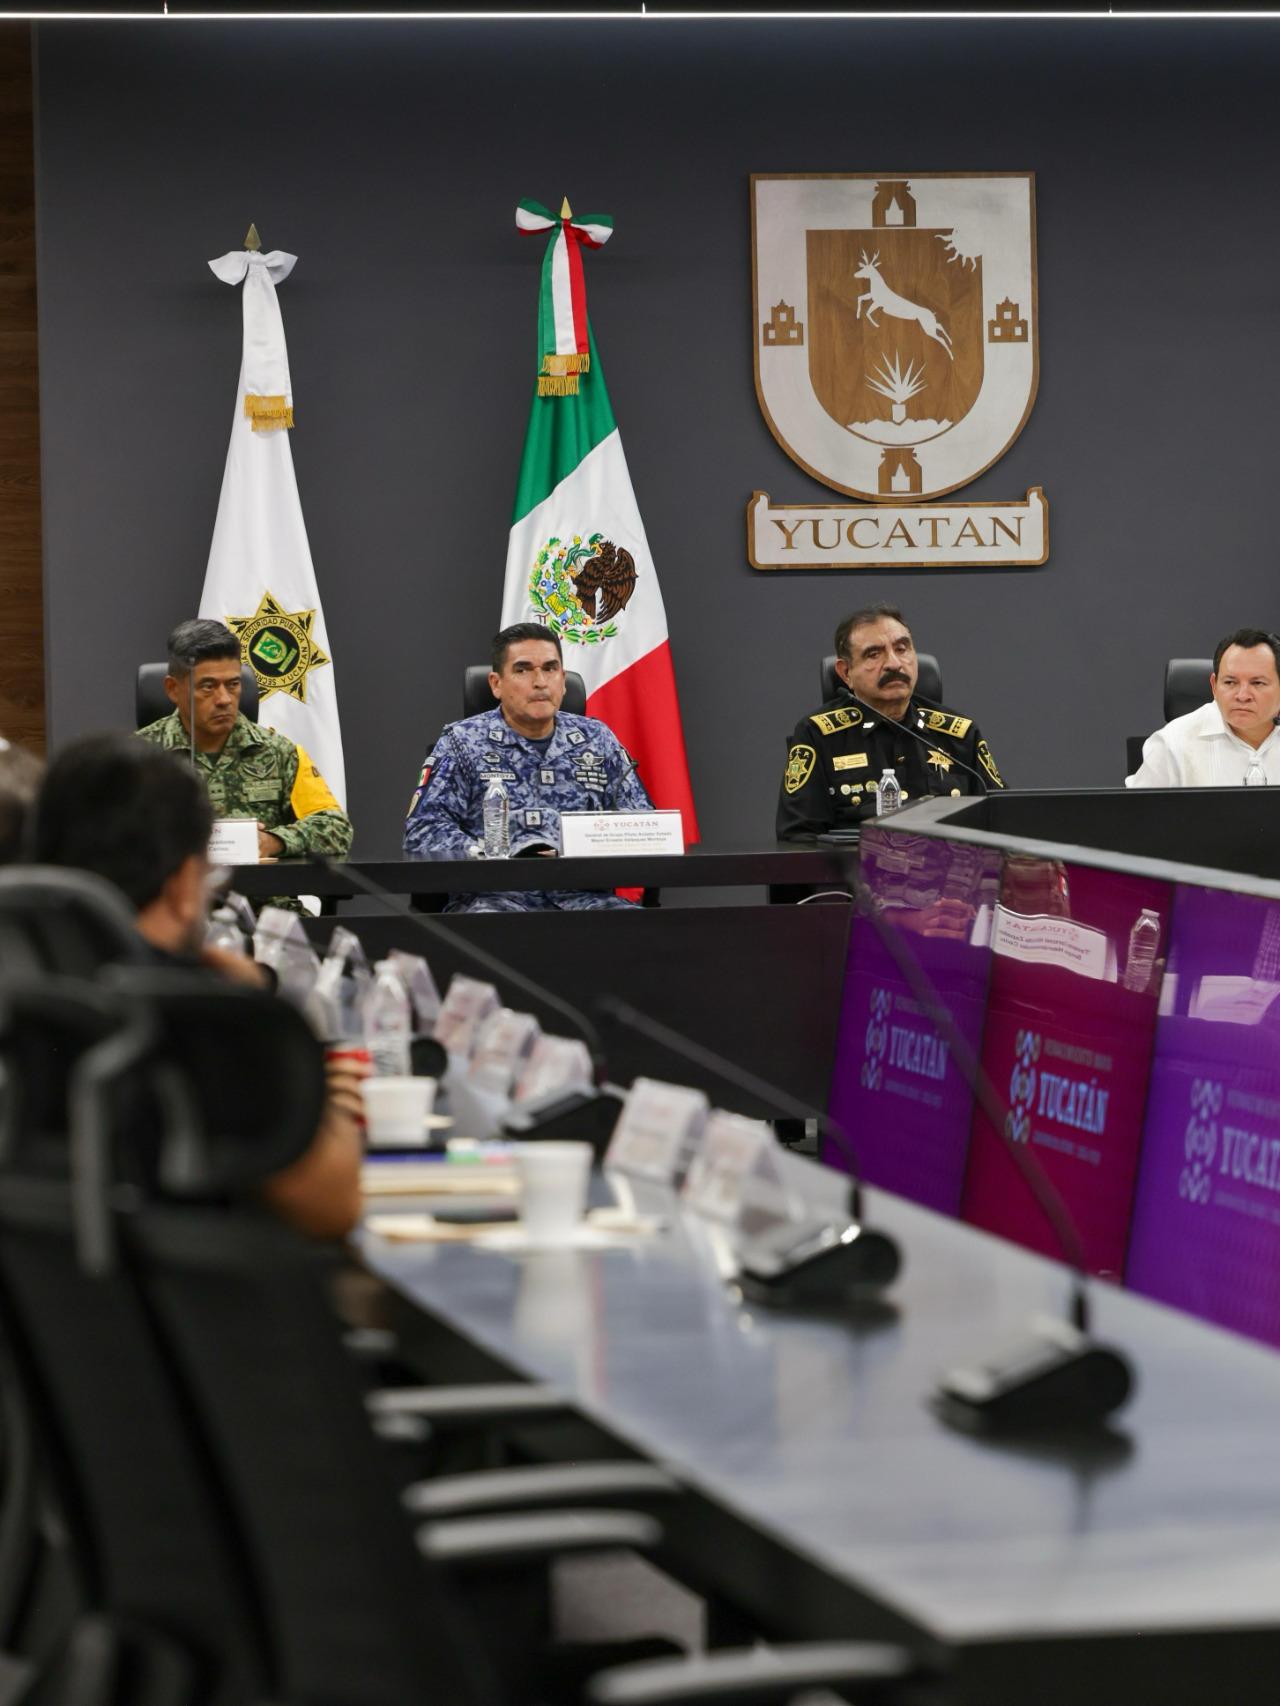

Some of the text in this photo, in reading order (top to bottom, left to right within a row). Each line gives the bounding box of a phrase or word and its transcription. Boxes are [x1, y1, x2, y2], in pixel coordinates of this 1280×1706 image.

[770, 516, 1026, 550] YUCATAN
[243, 618, 278, 641] SEGURIDAD
[888, 1025, 949, 1081] YUCATÁN
[1037, 1072, 1109, 1135] YUCATÁN
